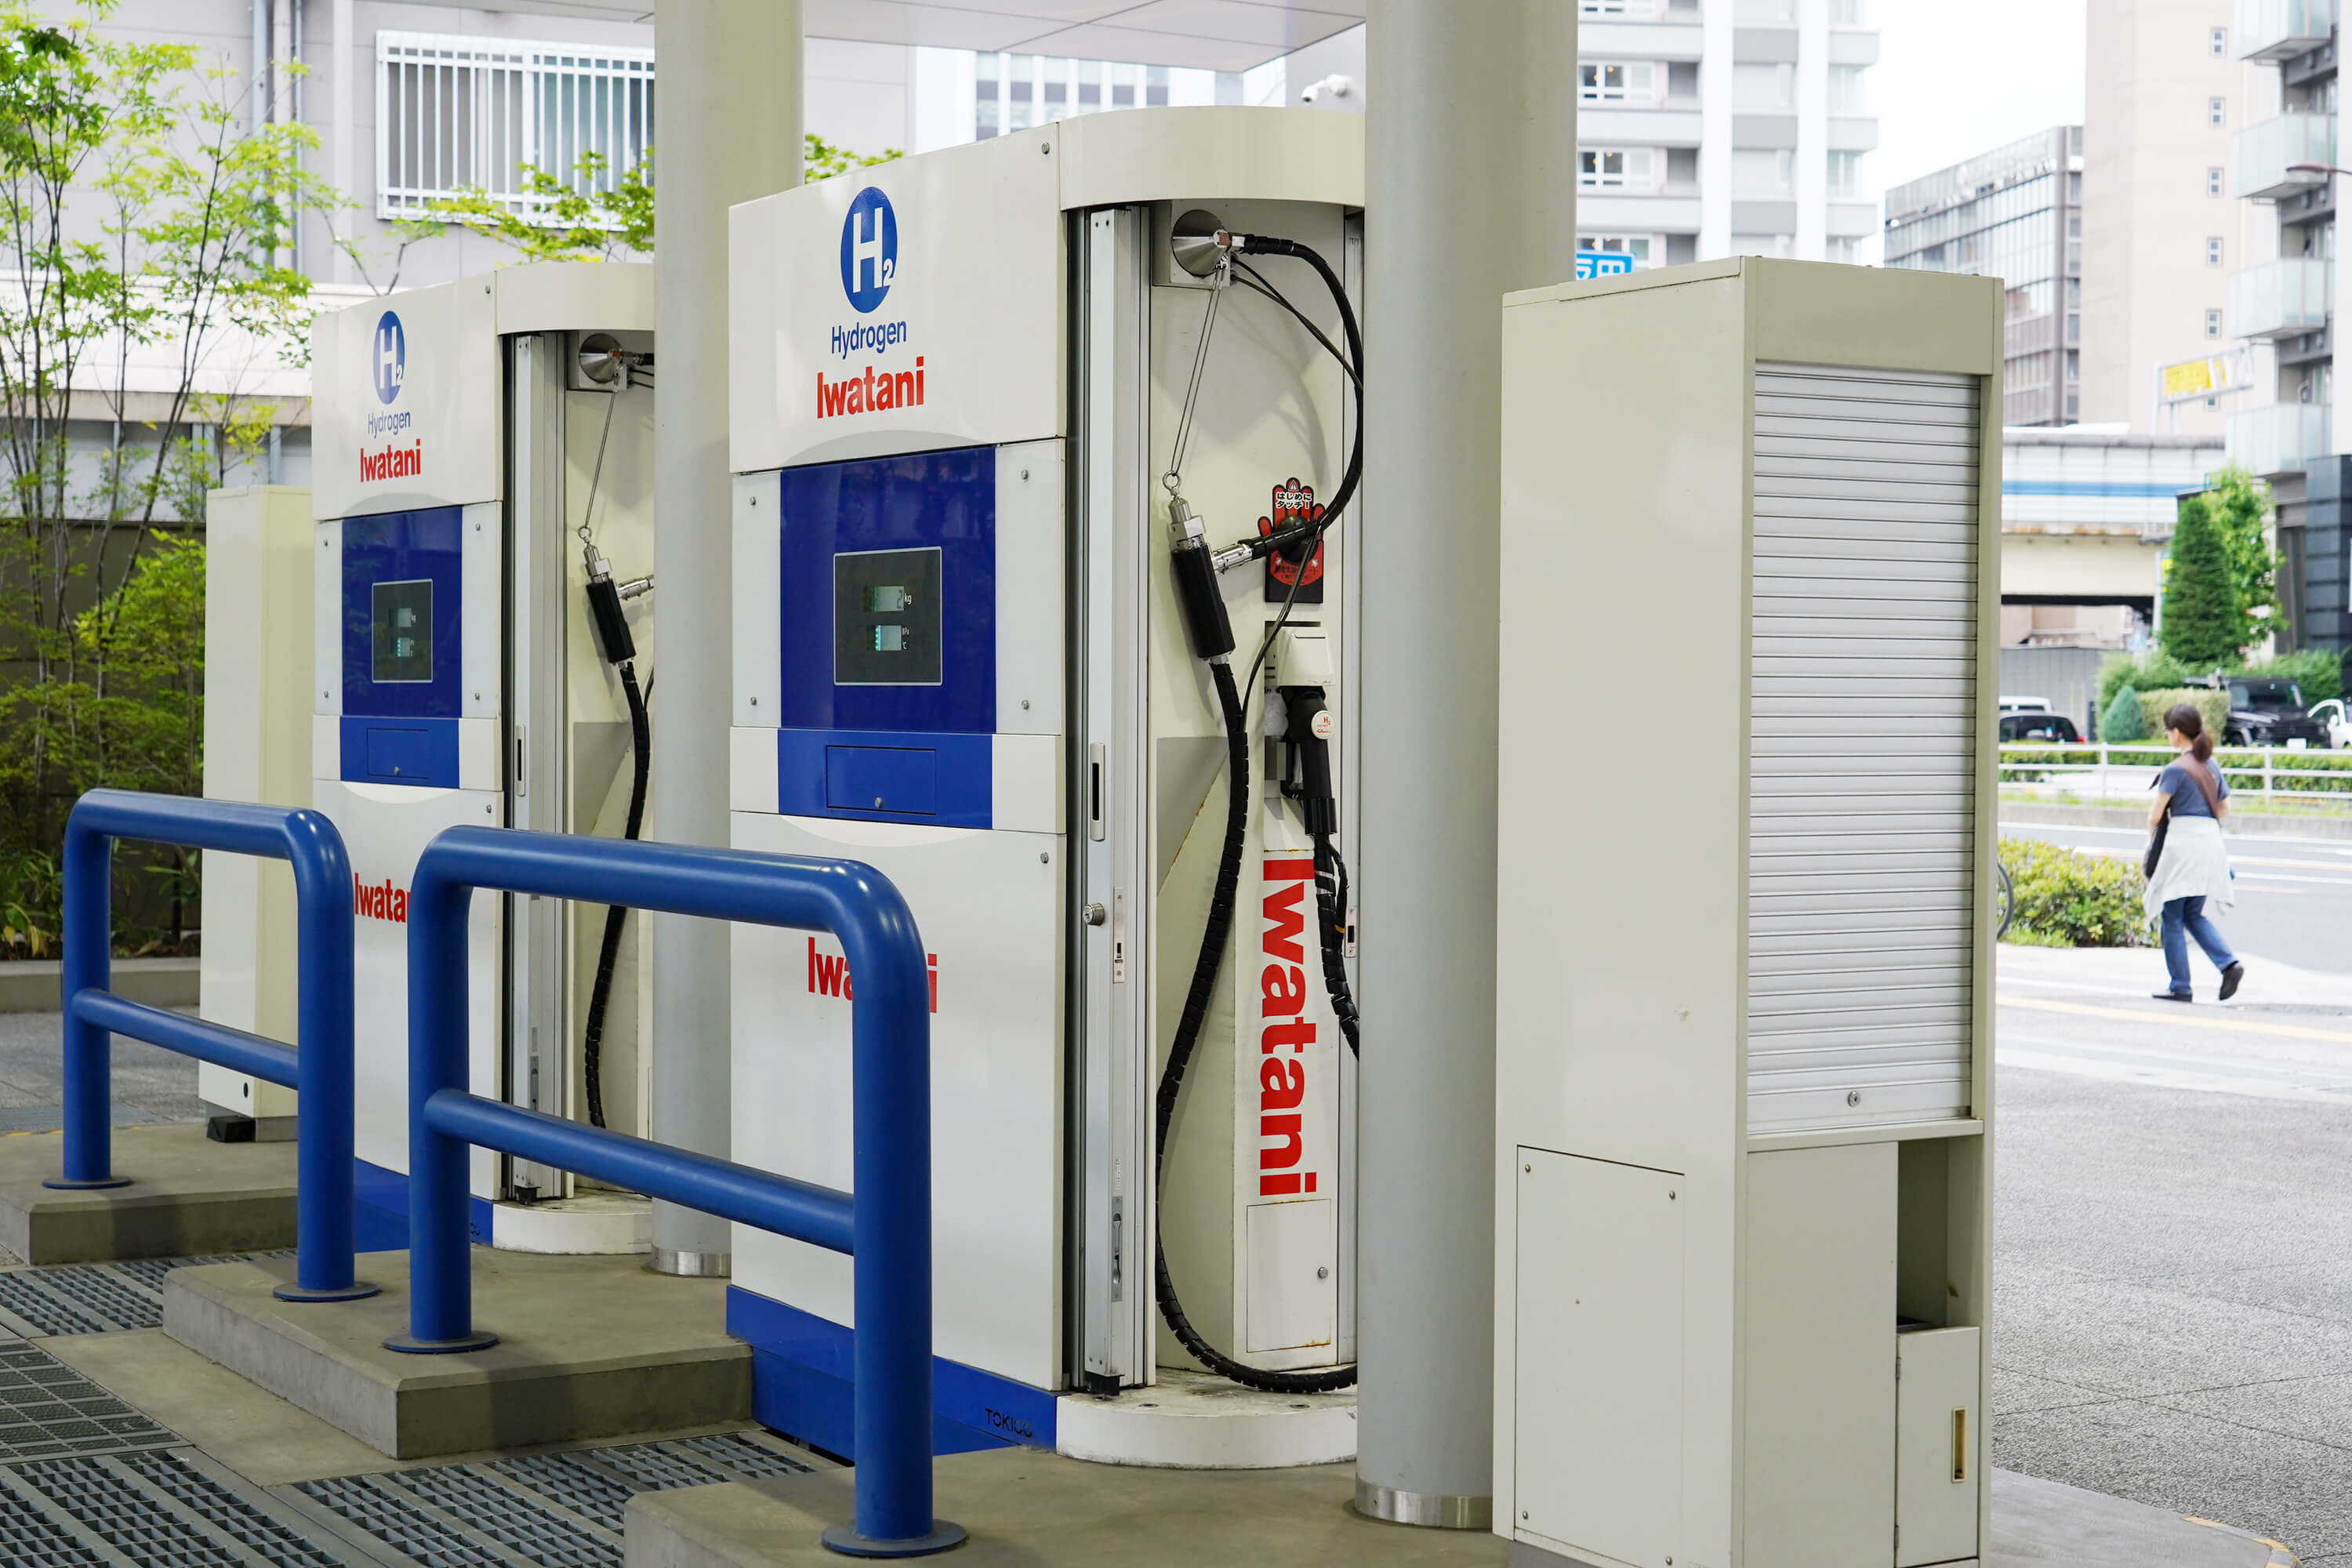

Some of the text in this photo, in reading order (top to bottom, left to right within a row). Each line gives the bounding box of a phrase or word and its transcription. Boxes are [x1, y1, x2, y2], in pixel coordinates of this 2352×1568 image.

[832, 320, 906, 360] Hydrogen
[817, 356, 924, 419] Iwatani
[368, 411, 412, 439] Hydrogen
[360, 438, 421, 482] Iwatani
[1276, 492, 1312, 501] はじめに
[905, 593, 912, 604] kg
[354, 873, 411, 923] Iwata
[1260, 858, 1316, 1196] Iwatani
